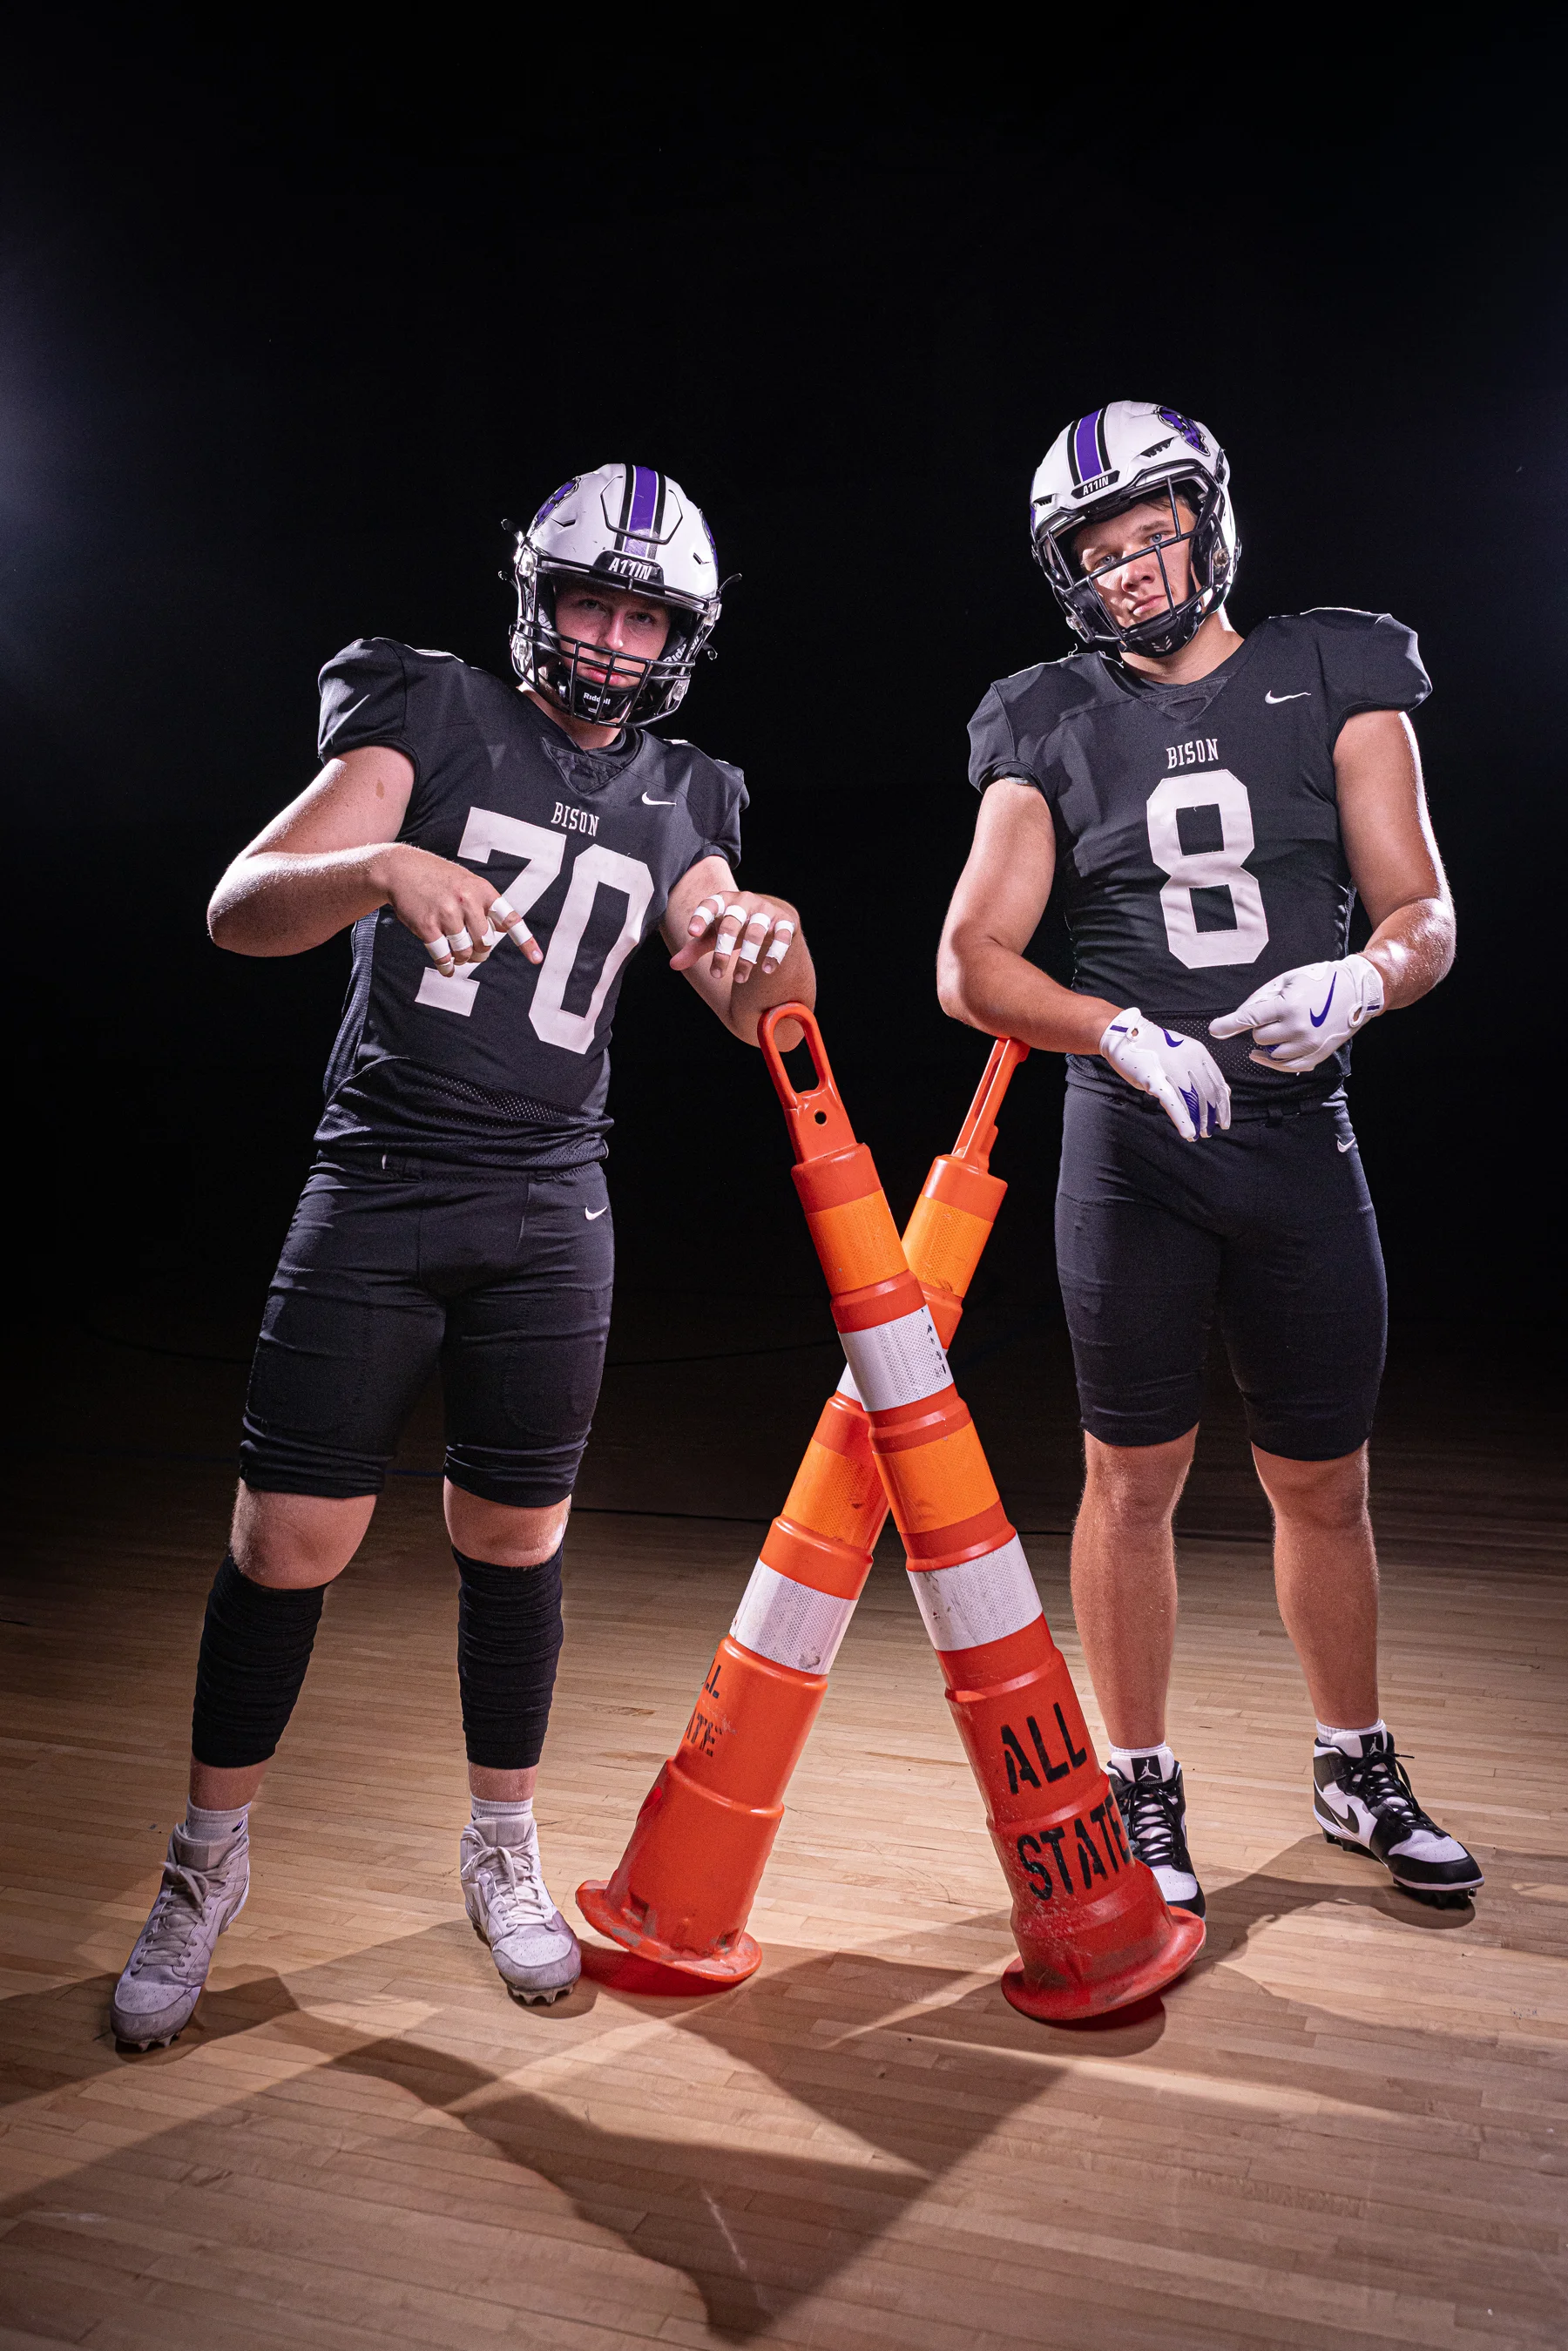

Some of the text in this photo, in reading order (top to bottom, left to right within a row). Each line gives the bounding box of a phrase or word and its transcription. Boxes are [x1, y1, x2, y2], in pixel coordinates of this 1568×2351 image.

[583, 692, 612, 706] Riddll
[1166, 738, 1220, 770] BISON
[551, 801, 599, 837] BISON
[1146, 768, 1270, 969] 8
[415, 806, 655, 1055] 70
[1000, 1702, 1088, 1795] ALL
[1017, 1793, 1132, 1902] STATE
